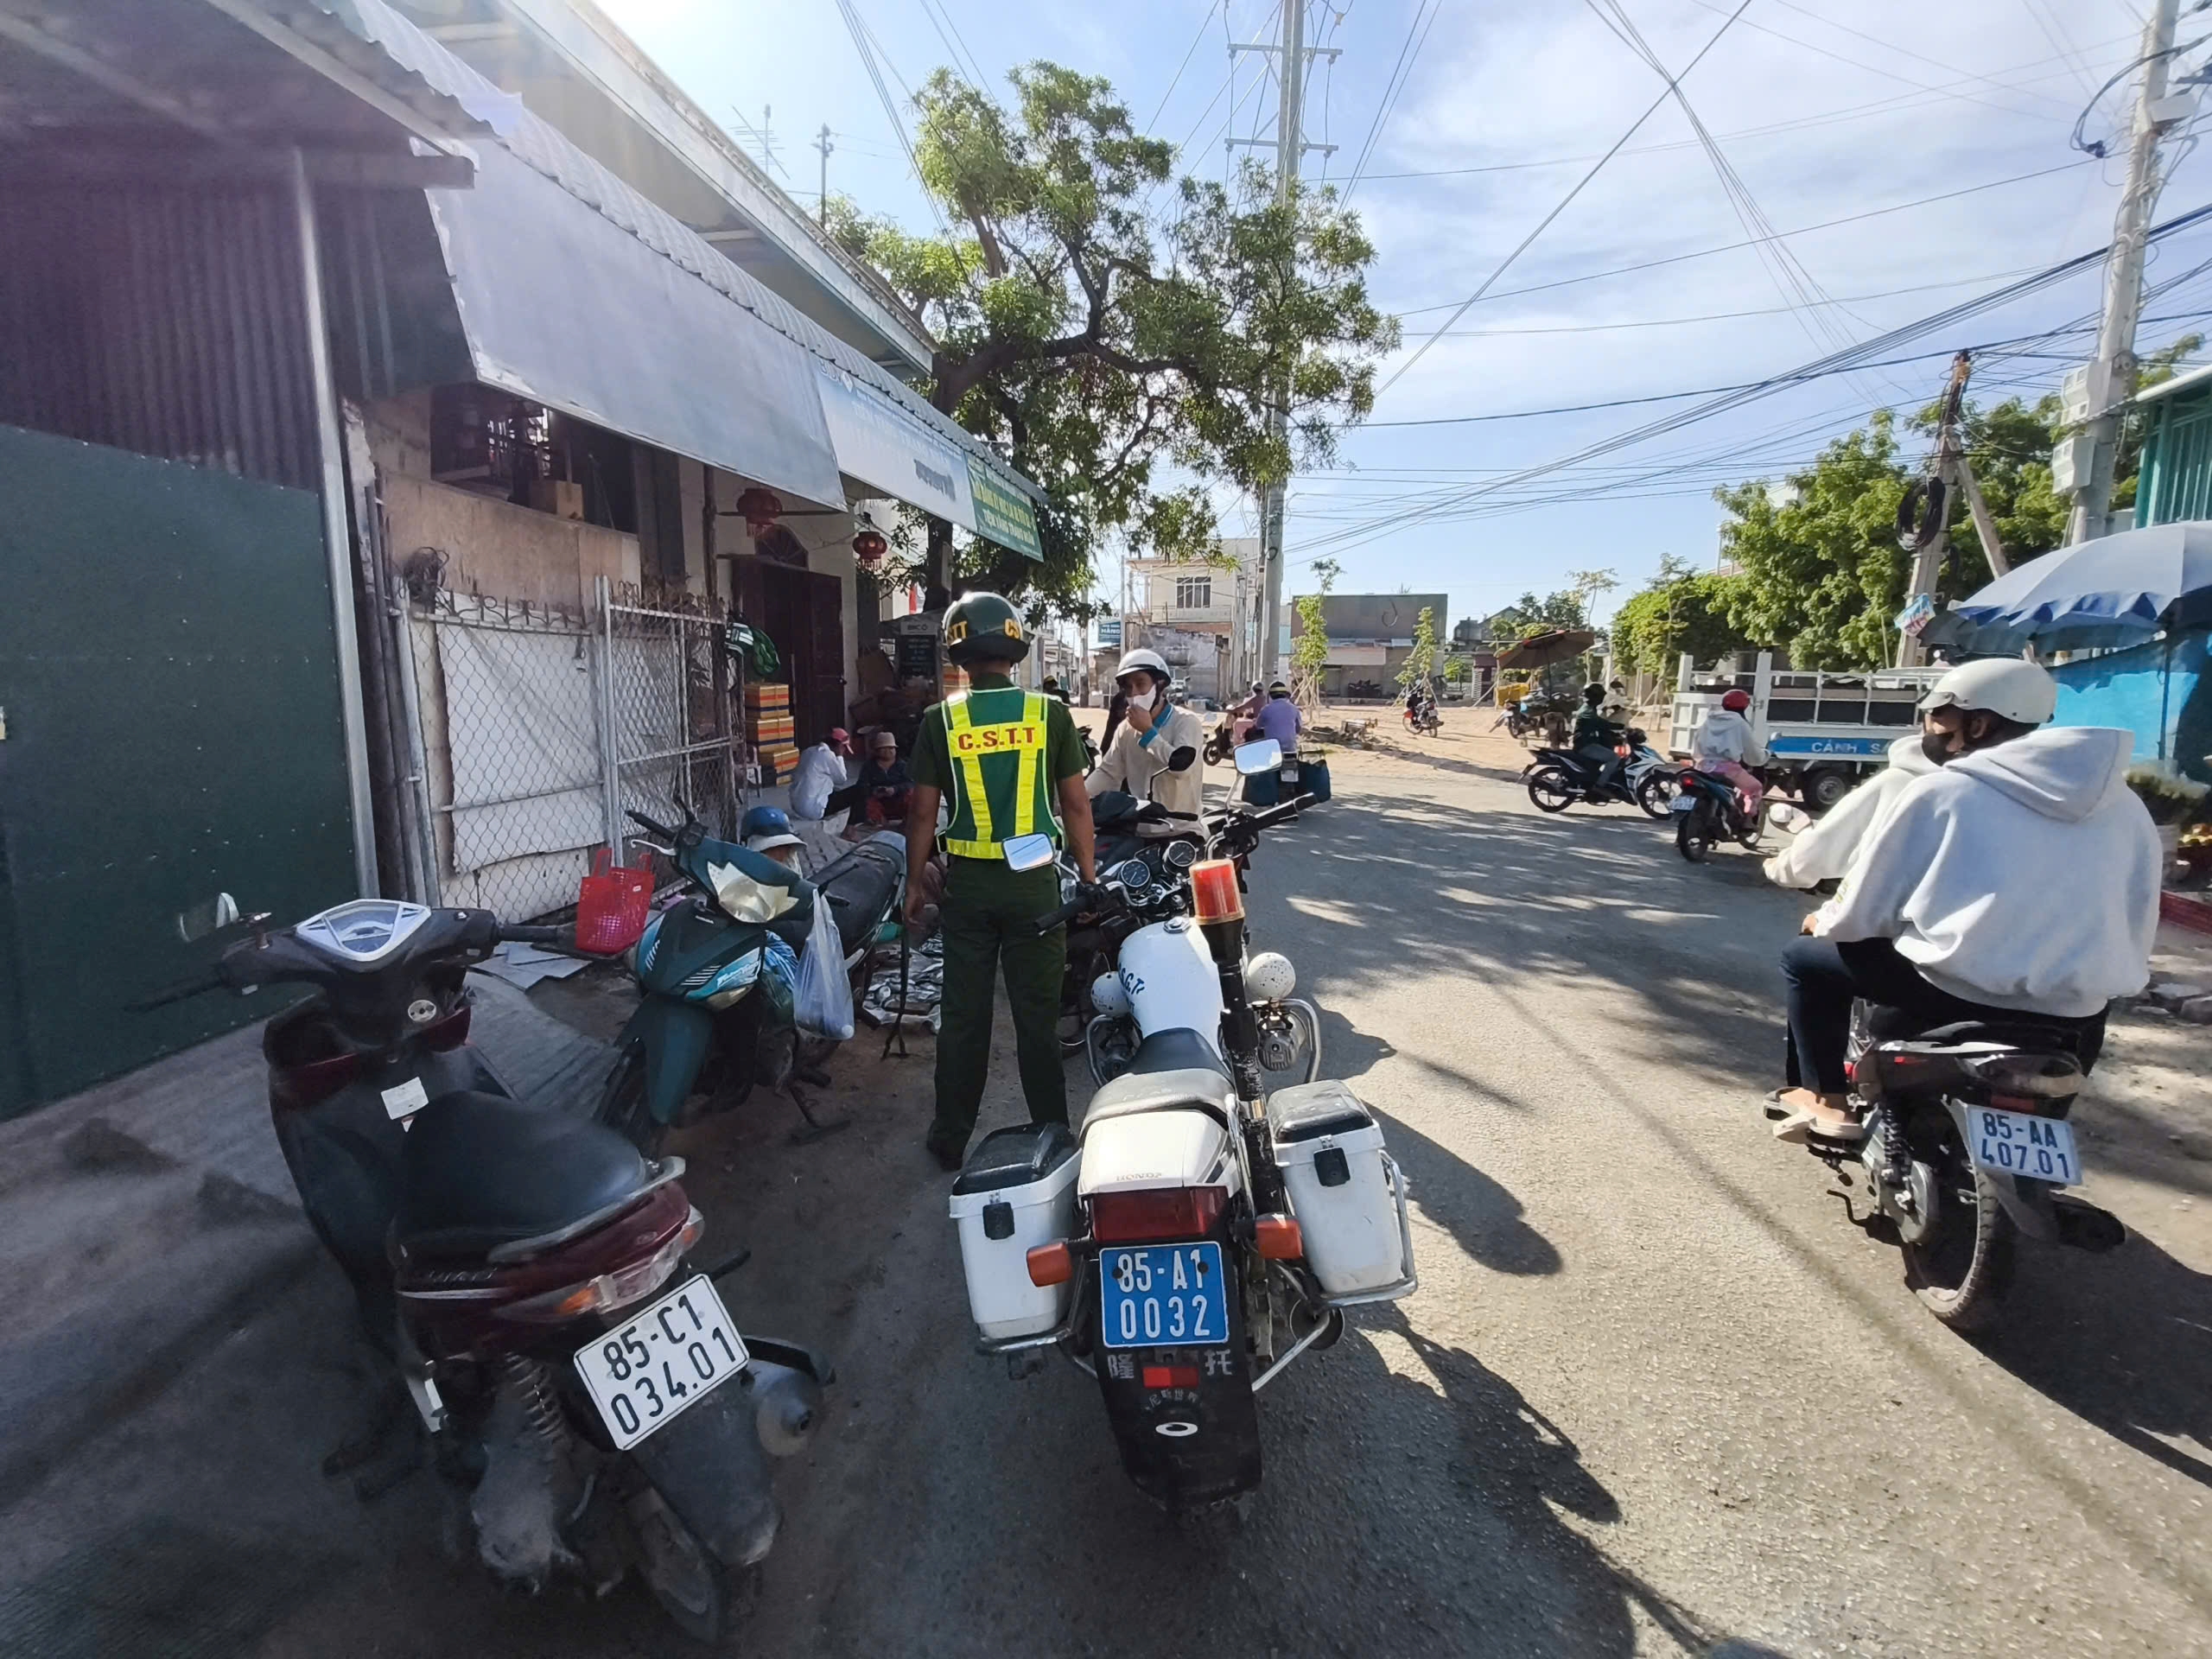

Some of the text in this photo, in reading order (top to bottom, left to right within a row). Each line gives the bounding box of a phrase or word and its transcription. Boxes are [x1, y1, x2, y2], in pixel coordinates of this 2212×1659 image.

[958, 727, 1035, 750] C.S.T.T
[1982, 1112, 2057, 1147] 85-AA
[1981, 1138, 2069, 1178] 407.01
[1117, 1249, 1204, 1293] 85-A1
[603, 1294, 702, 1381] 85-C1
[1120, 1295, 1211, 1339] 0032
[611, 1326, 736, 1434] 034.01
